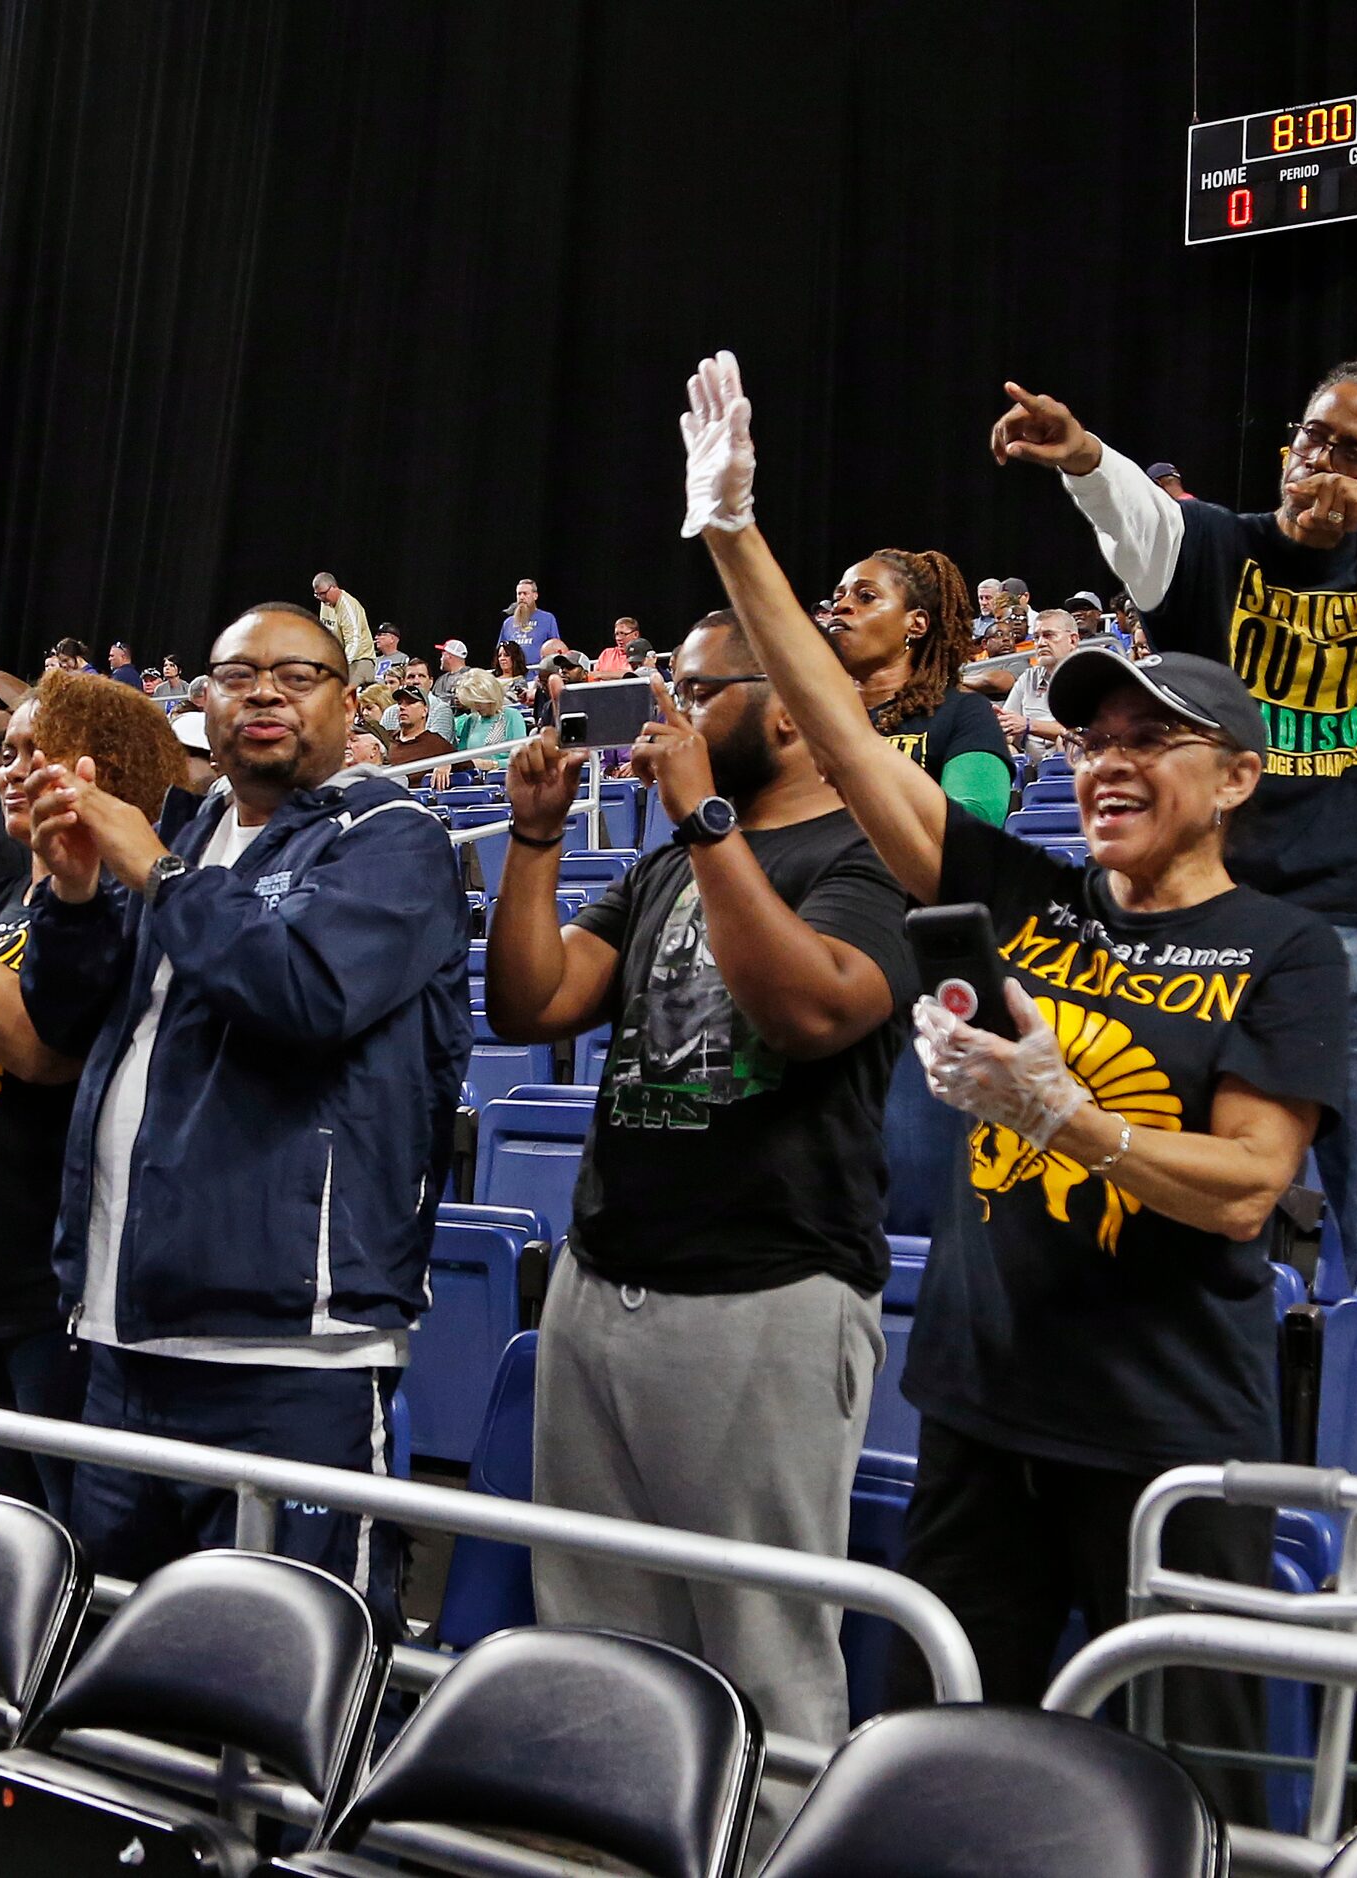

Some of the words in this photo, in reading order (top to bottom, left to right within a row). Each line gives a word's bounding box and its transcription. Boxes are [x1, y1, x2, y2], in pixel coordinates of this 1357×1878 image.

[1273, 103, 1353, 152] 8:00
[1201, 166, 1248, 190] HOME
[1279, 164, 1320, 182] PERIOD
[1230, 189, 1251, 226] 0
[1301, 184, 1308, 210] 1
[1298, 754, 1313, 776] IS
[997, 914, 1252, 1022] MADISON
[1153, 944, 1254, 967] James
